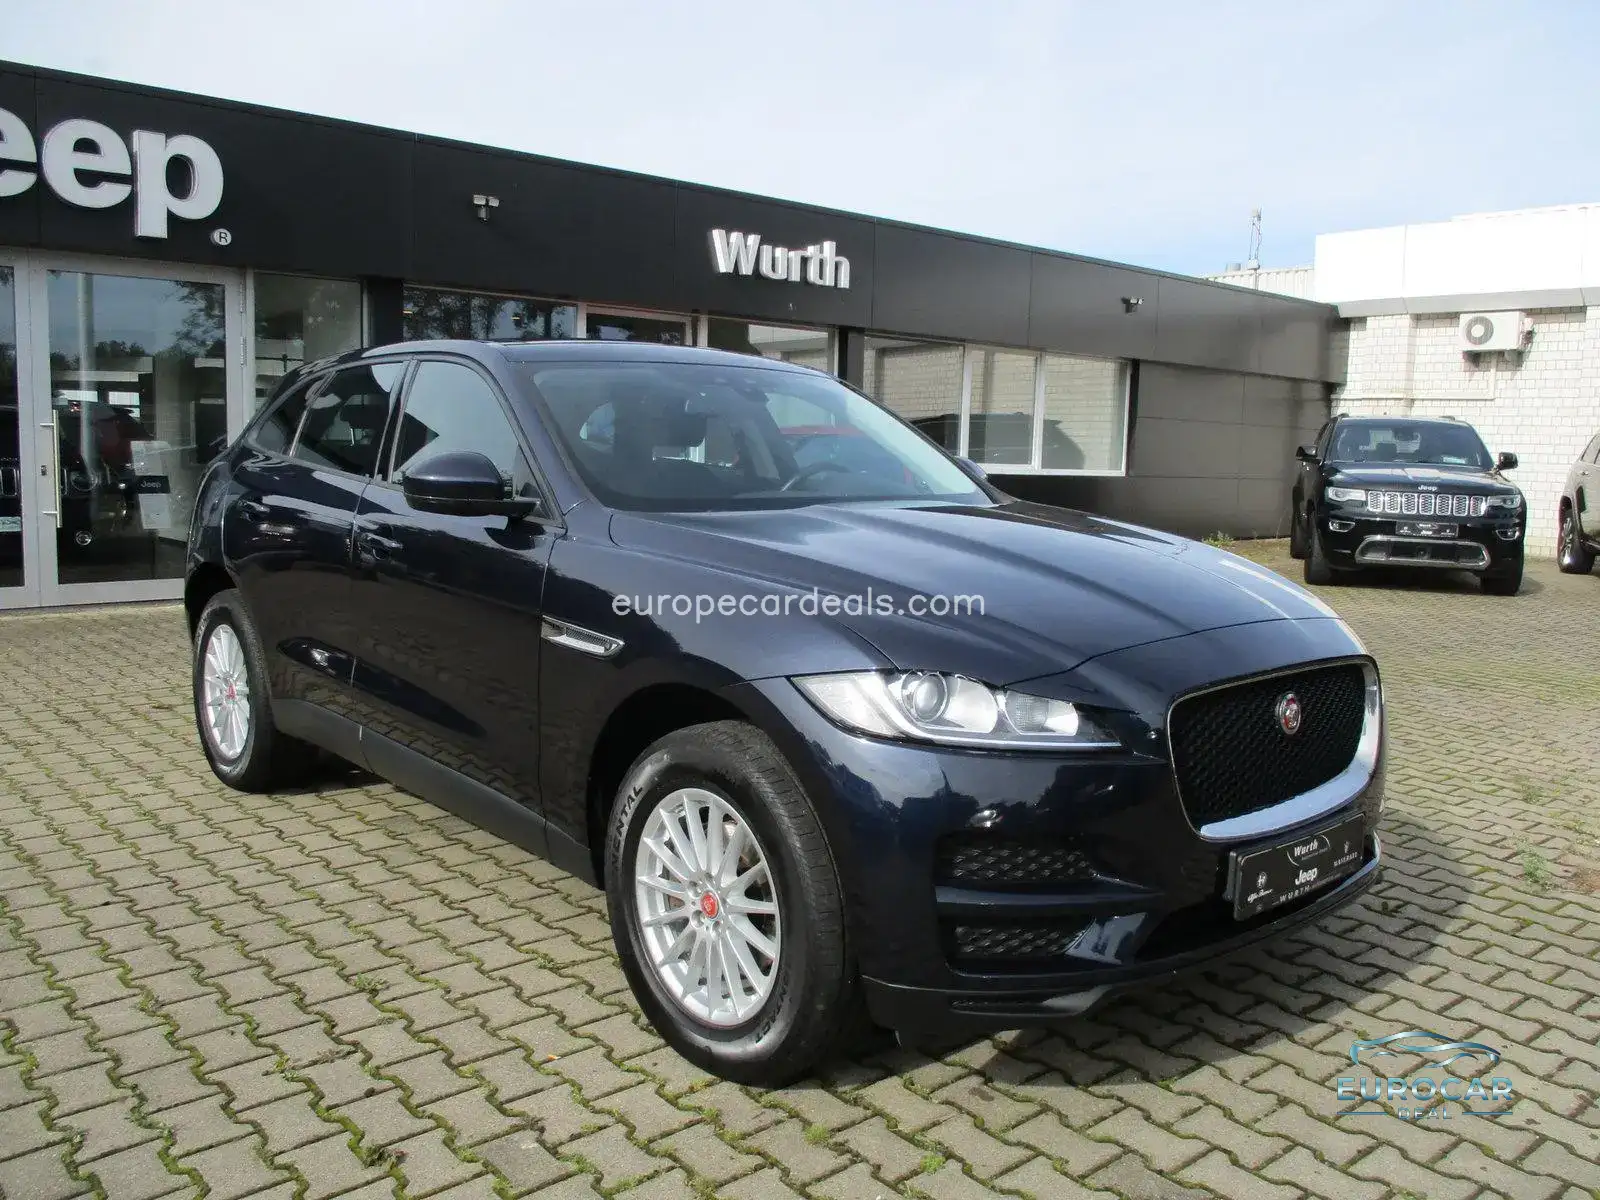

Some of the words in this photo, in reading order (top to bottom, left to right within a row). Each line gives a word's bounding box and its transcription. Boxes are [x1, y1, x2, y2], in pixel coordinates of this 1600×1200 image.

[710, 228, 850, 289] Wurth
[141, 480, 162, 488] Jeep
[1294, 839, 1318, 857] Wurth
[1294, 867, 1318, 885] Jeep
